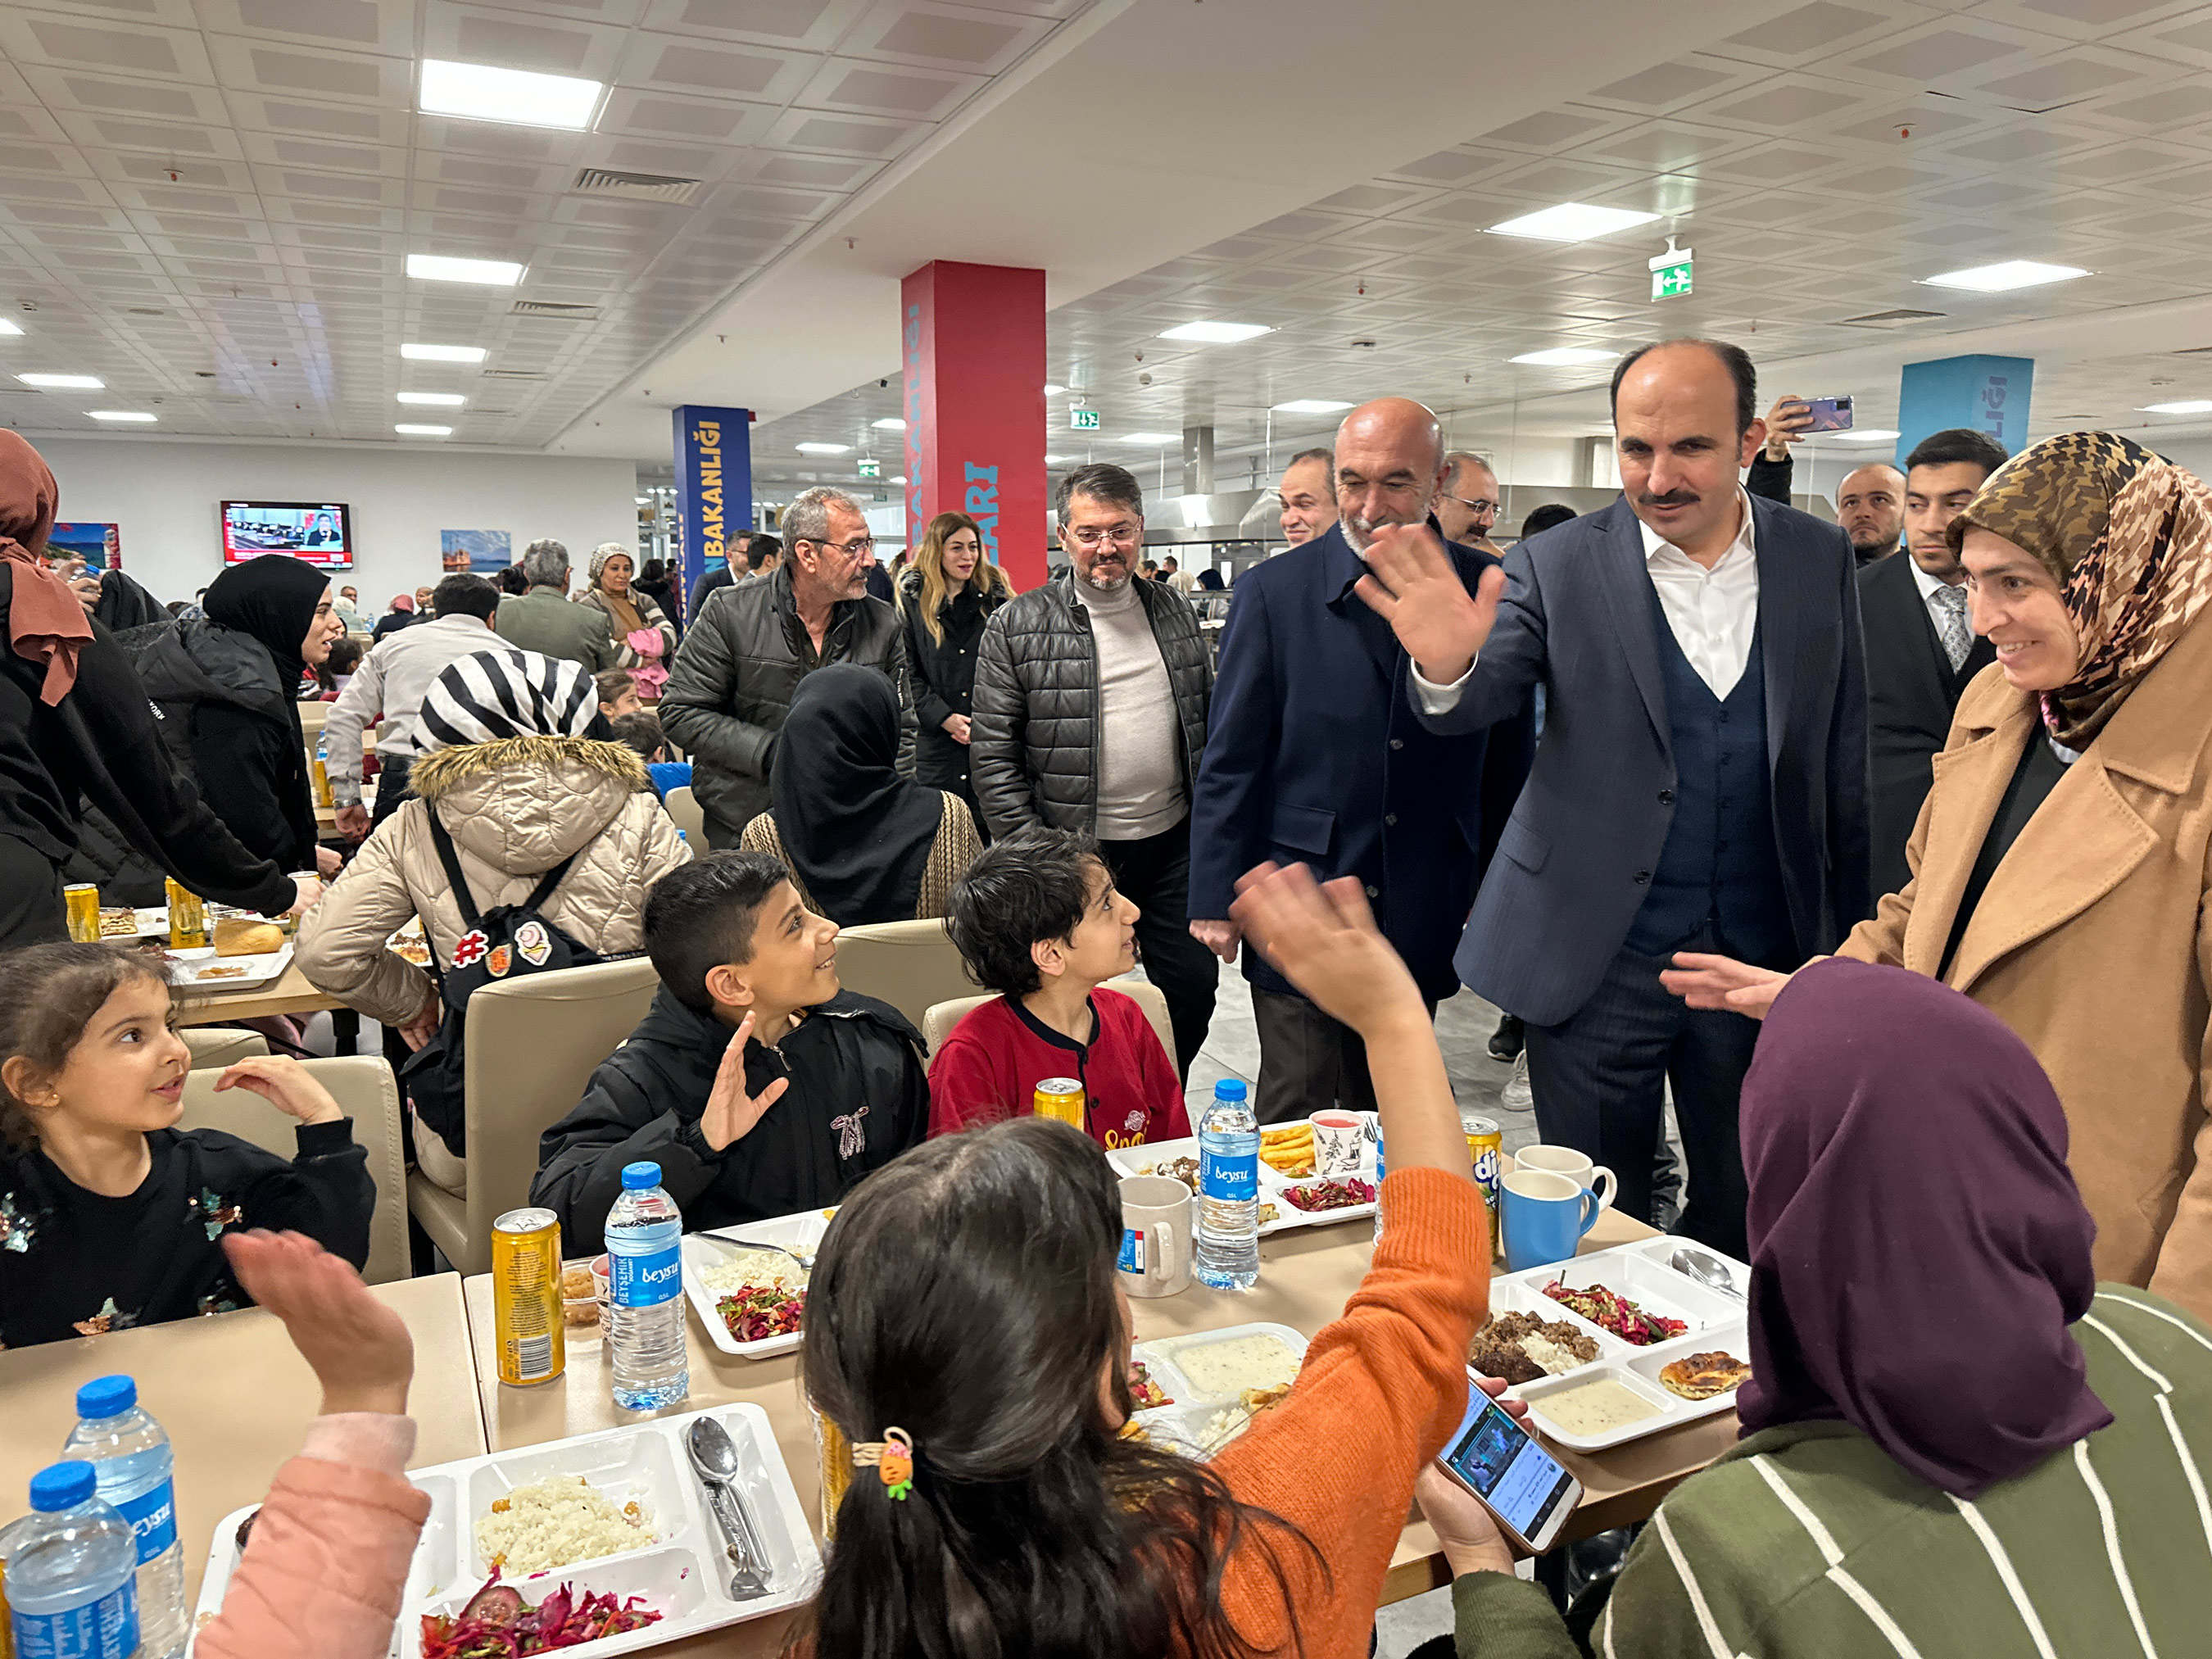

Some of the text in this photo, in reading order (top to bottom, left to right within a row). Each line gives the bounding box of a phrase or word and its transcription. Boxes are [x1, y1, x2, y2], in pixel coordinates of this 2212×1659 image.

[1215, 1166, 1249, 1183] beysu
[641, 1262, 678, 1284] beysu
[131, 1503, 170, 1537] eysu
